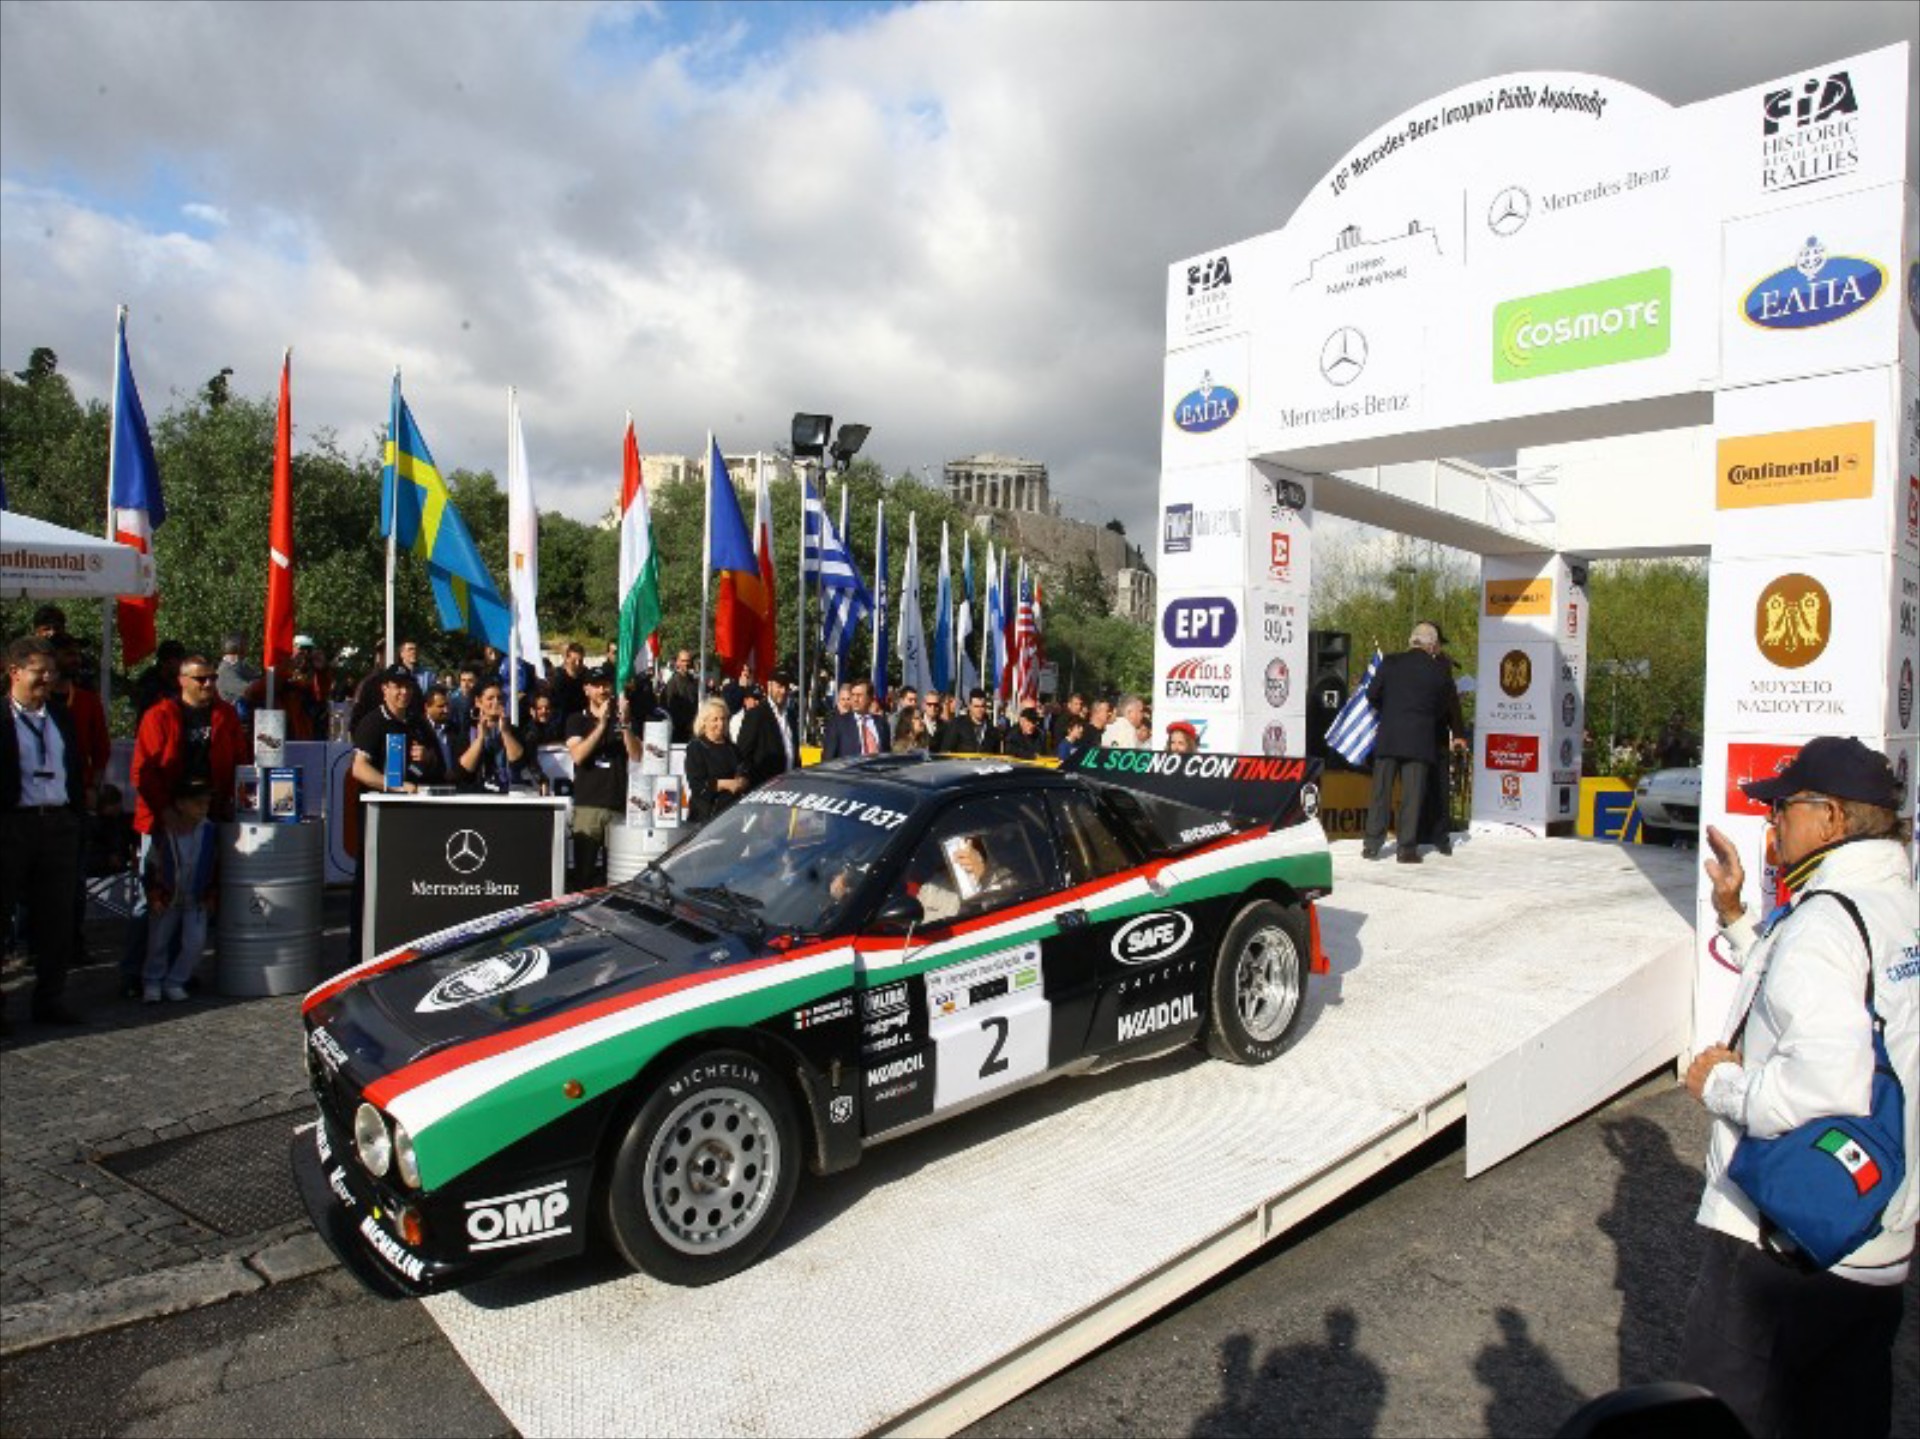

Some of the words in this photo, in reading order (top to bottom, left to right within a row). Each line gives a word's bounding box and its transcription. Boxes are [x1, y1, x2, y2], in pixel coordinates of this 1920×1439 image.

[1350, 113, 1439, 178] Mercedes-Benz
[1763, 117, 1858, 156] HISTORIC
[1763, 151, 1858, 187] RALLIES
[1541, 165, 1671, 215] Mercedes-Benz
[1759, 275, 1865, 319] ΕΛΠΑ
[1516, 299, 1661, 350] COSMOTE
[1280, 394, 1410, 430] Mercedes-Benz
[1727, 455, 1839, 486] Continental
[1750, 679, 1833, 694] ΜΟΥΣΕΙΟ
[1737, 699, 1845, 714] ΝΑΣΙΟΥΤΖΙΚ
[1081, 750, 1099, 769] IL
[1103, 750, 1182, 776] SOGNO
[1184, 756, 1306, 781] CONTINUA
[796, 793, 867, 817] RALLY
[859, 806, 907, 831] 037
[411, 880, 520, 896] Mercedes-Benz
[1127, 923, 1175, 953] SAFE
[979, 1016, 1009, 1080] 2
[668, 1064, 759, 1096] MICHELIN
[466, 1191, 570, 1242] OMP
